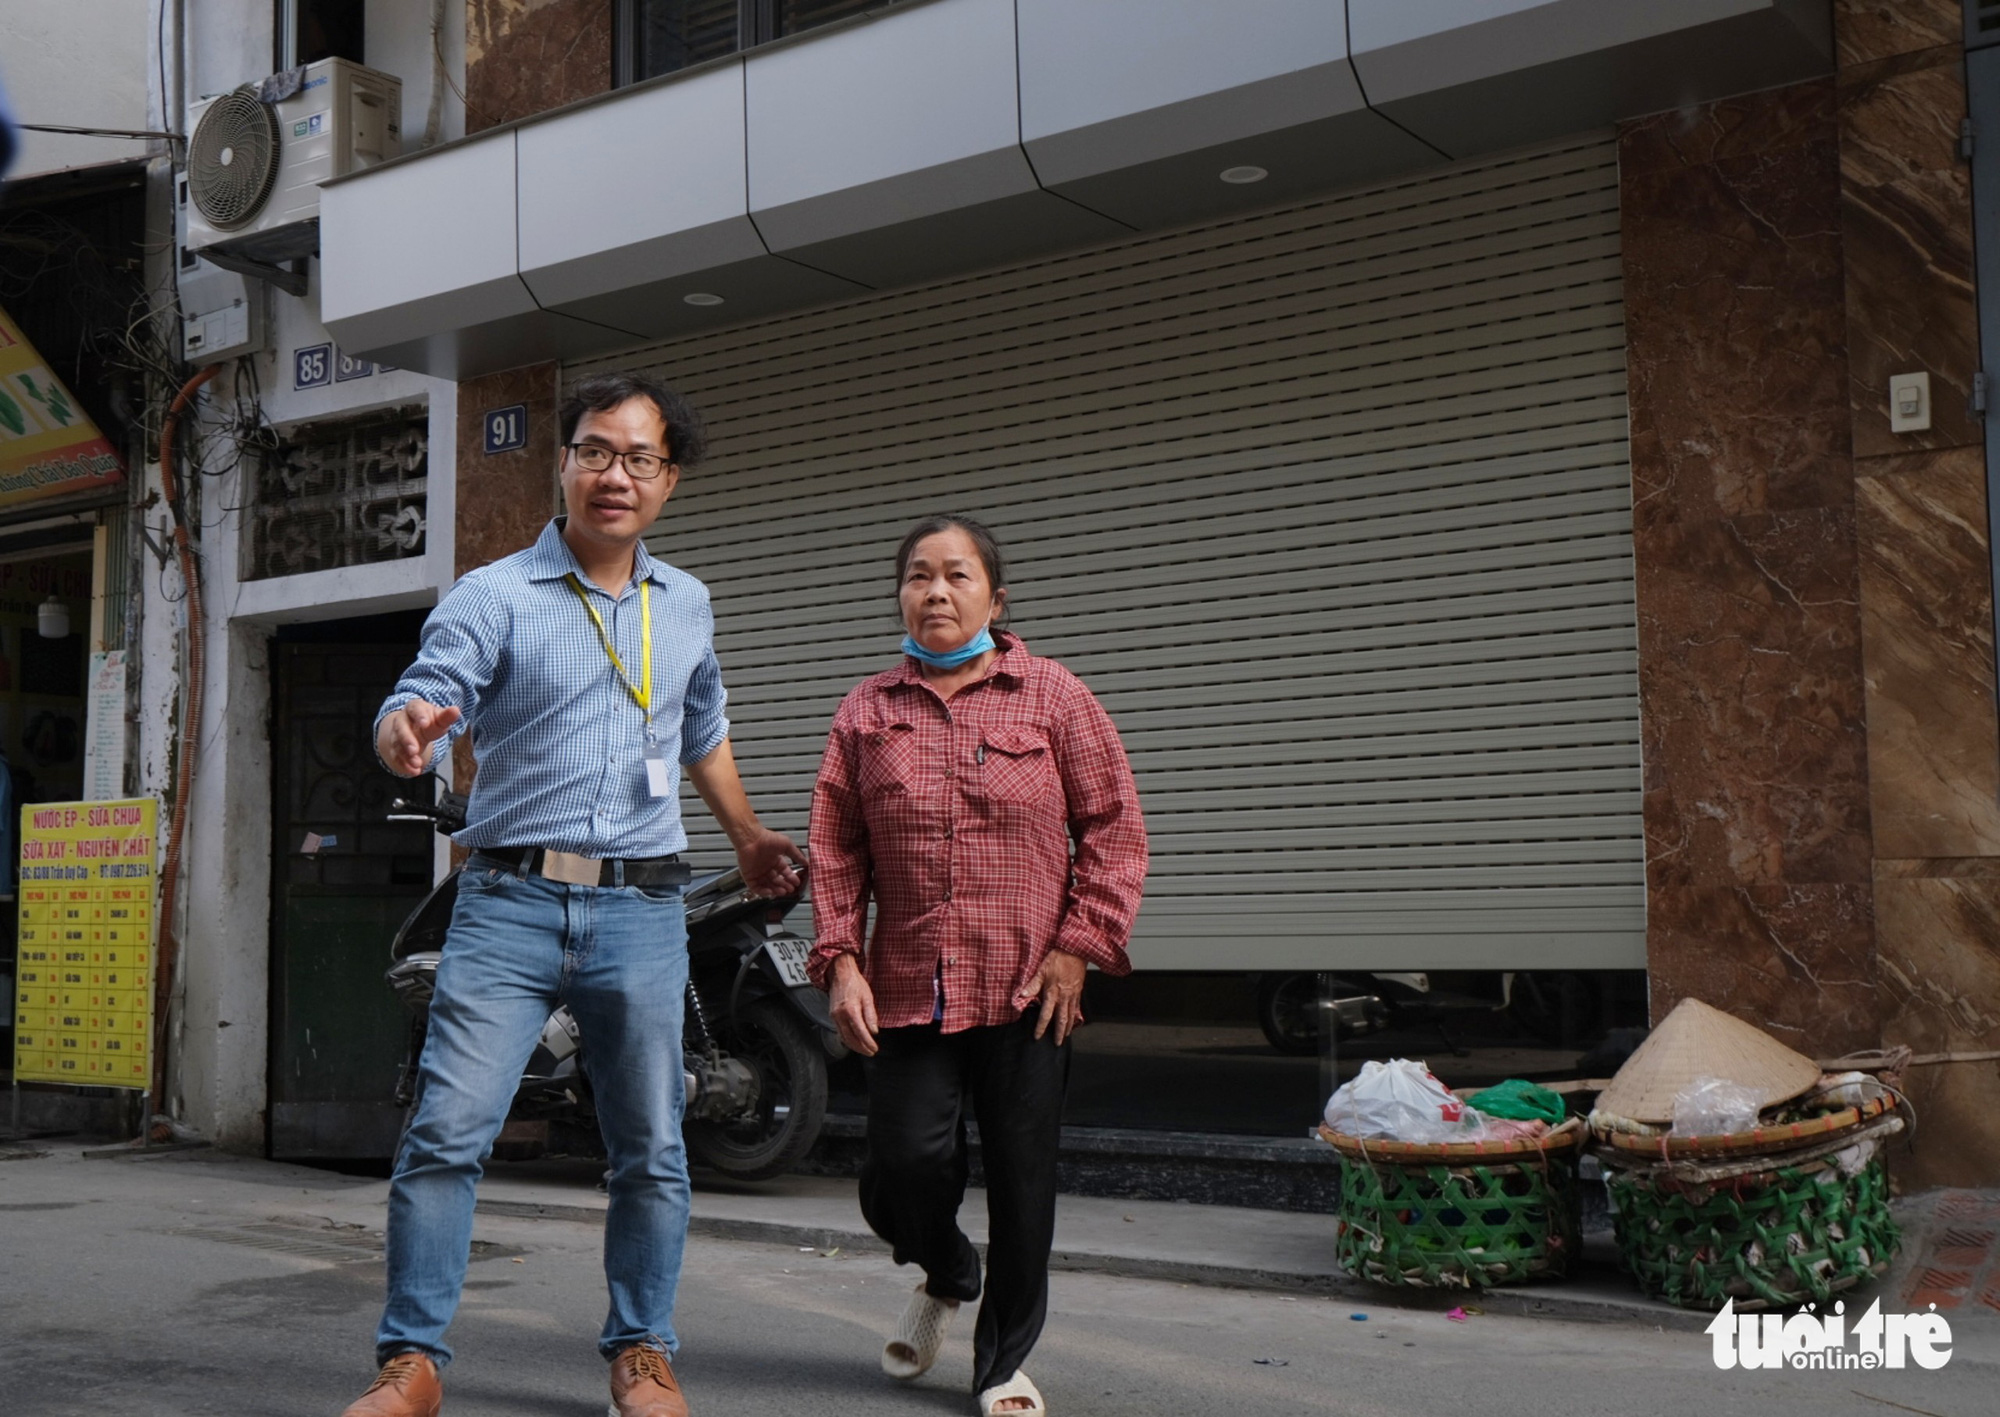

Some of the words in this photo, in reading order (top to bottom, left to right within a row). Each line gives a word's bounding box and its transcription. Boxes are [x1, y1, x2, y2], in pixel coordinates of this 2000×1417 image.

[300, 353, 324, 382] 85
[492, 413, 517, 446] 91
[0, 473, 38, 491] hông
[88, 805, 109, 827] SỮA
[113, 807, 141, 826] CHUA
[22, 839, 43, 859] SỮA
[47, 841, 66, 859] XAY
[76, 836, 119, 858] NGUYÊN
[787, 962, 808, 983] 46
